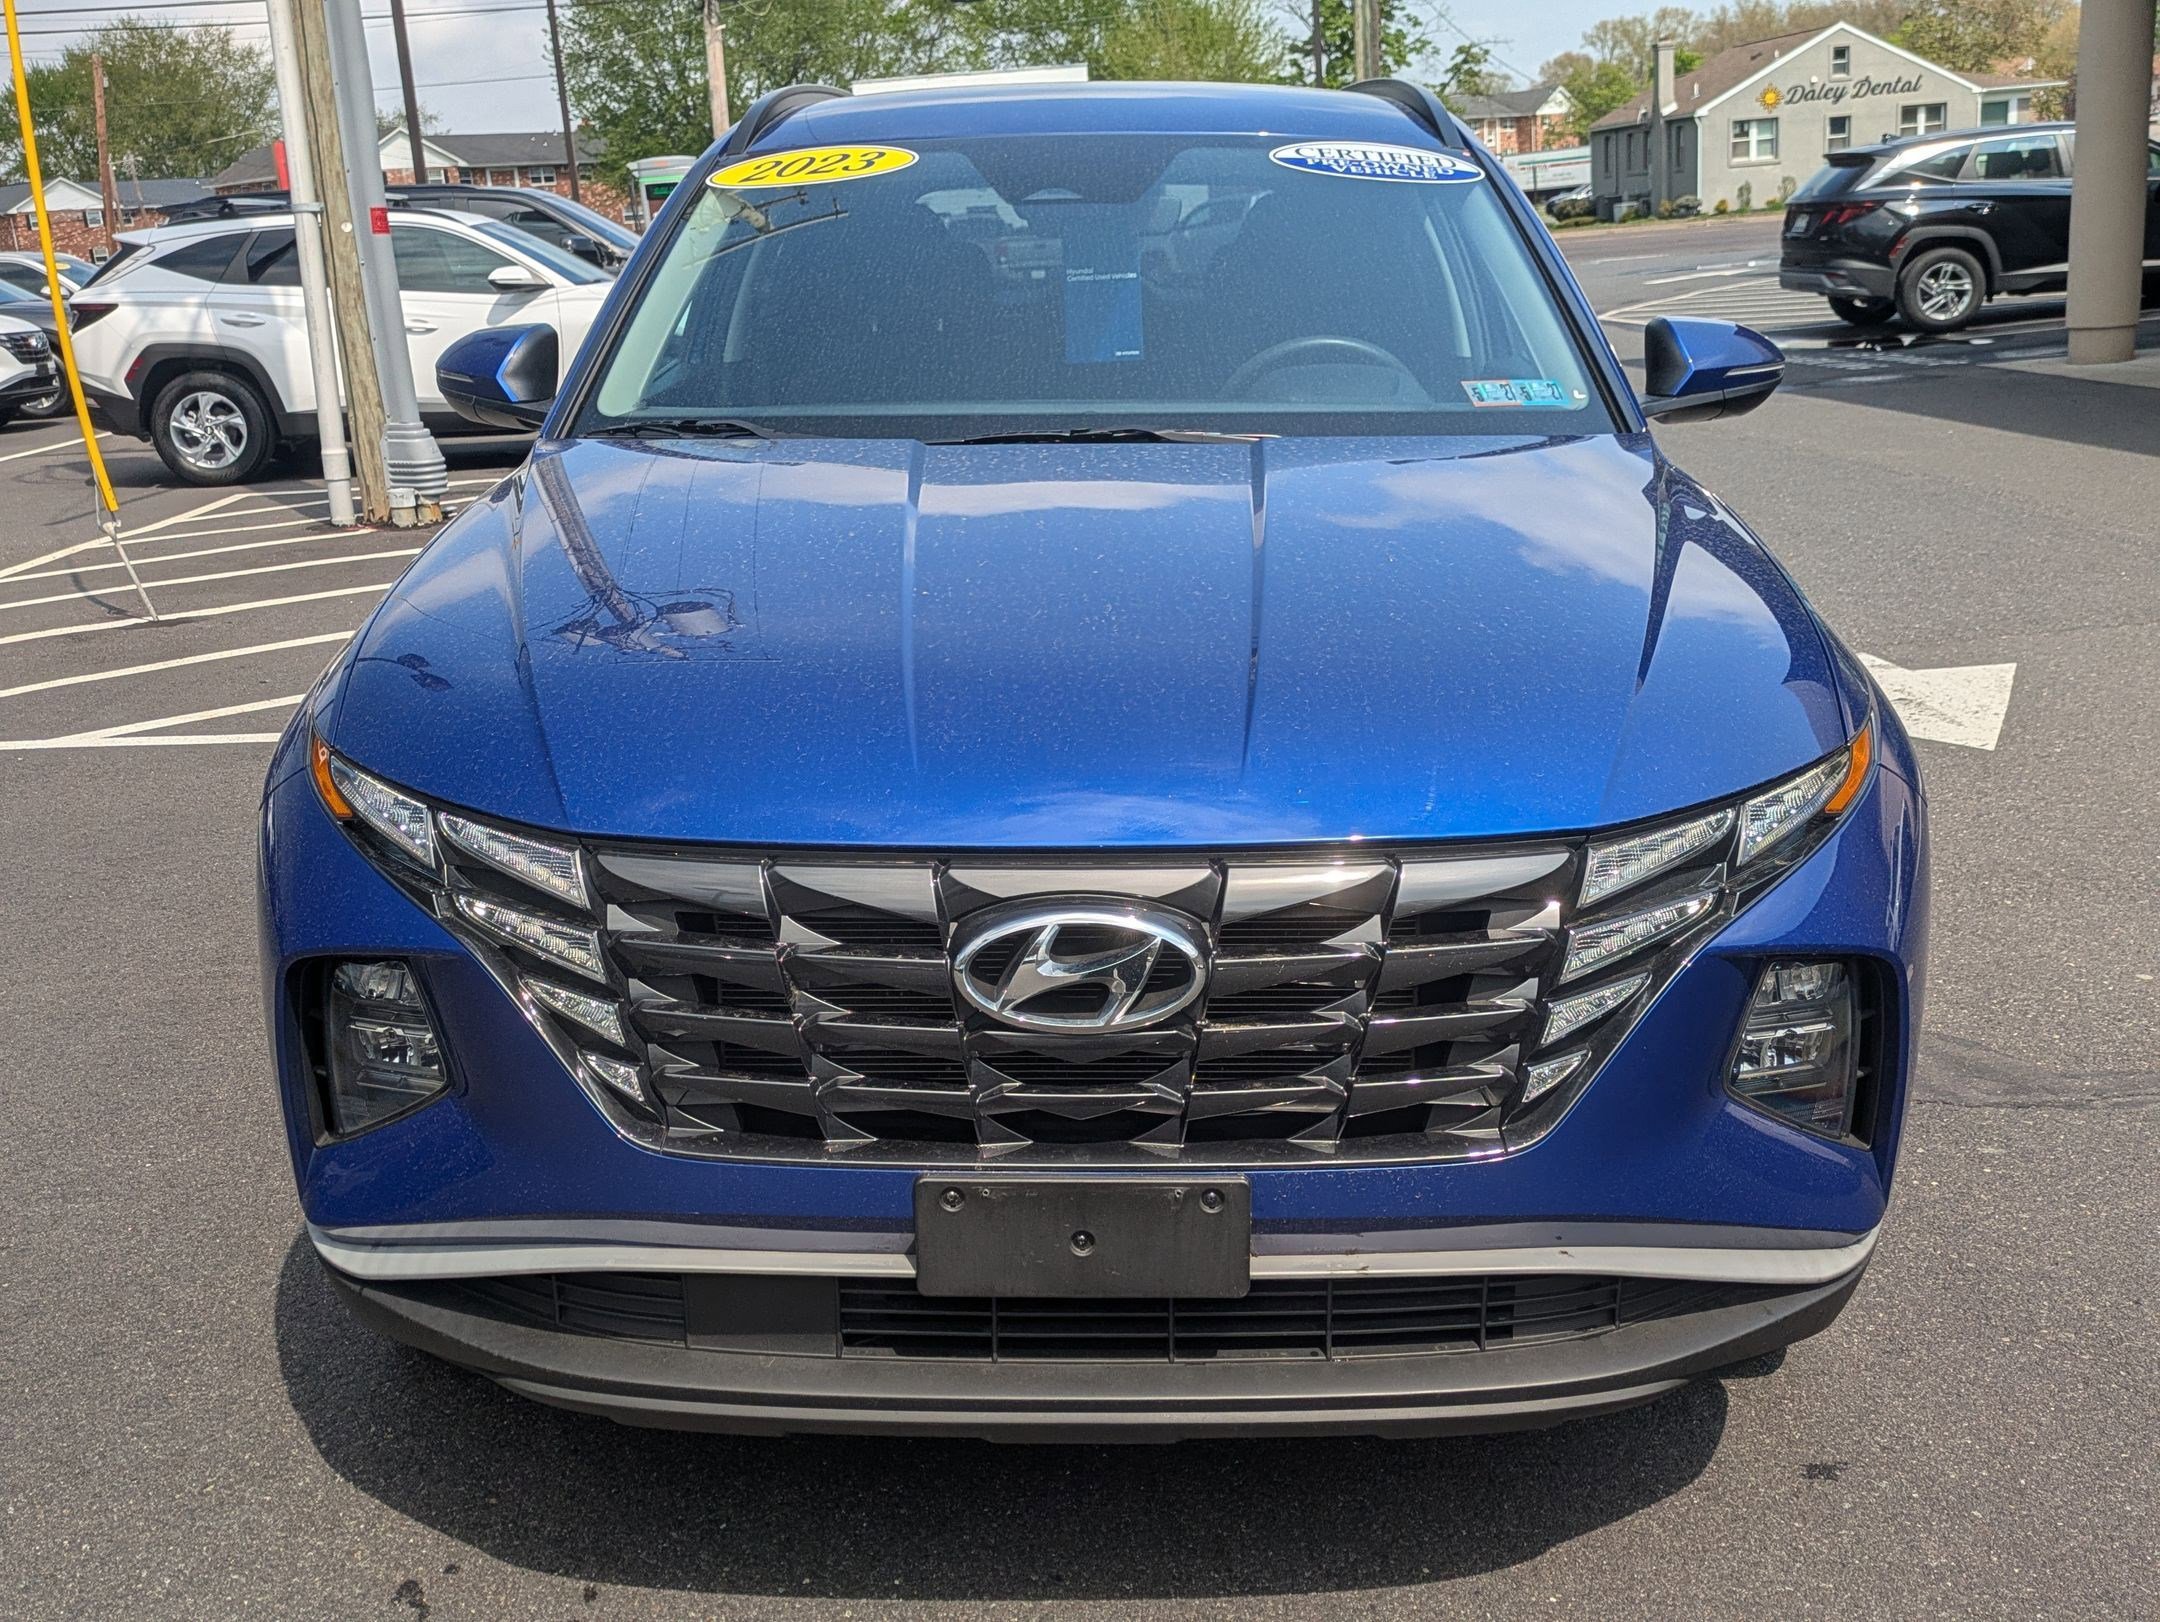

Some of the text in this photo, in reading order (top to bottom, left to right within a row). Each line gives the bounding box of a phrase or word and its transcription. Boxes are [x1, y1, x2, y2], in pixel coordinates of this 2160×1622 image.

[1784, 74, 1923, 105] Daley Dental
[738, 151, 887, 184] 2023
[1294, 147, 1457, 169] CERTIFIED
[1306, 158, 1455, 176] PRE-OWNED
[1331, 164, 1438, 180] VEHICLE
